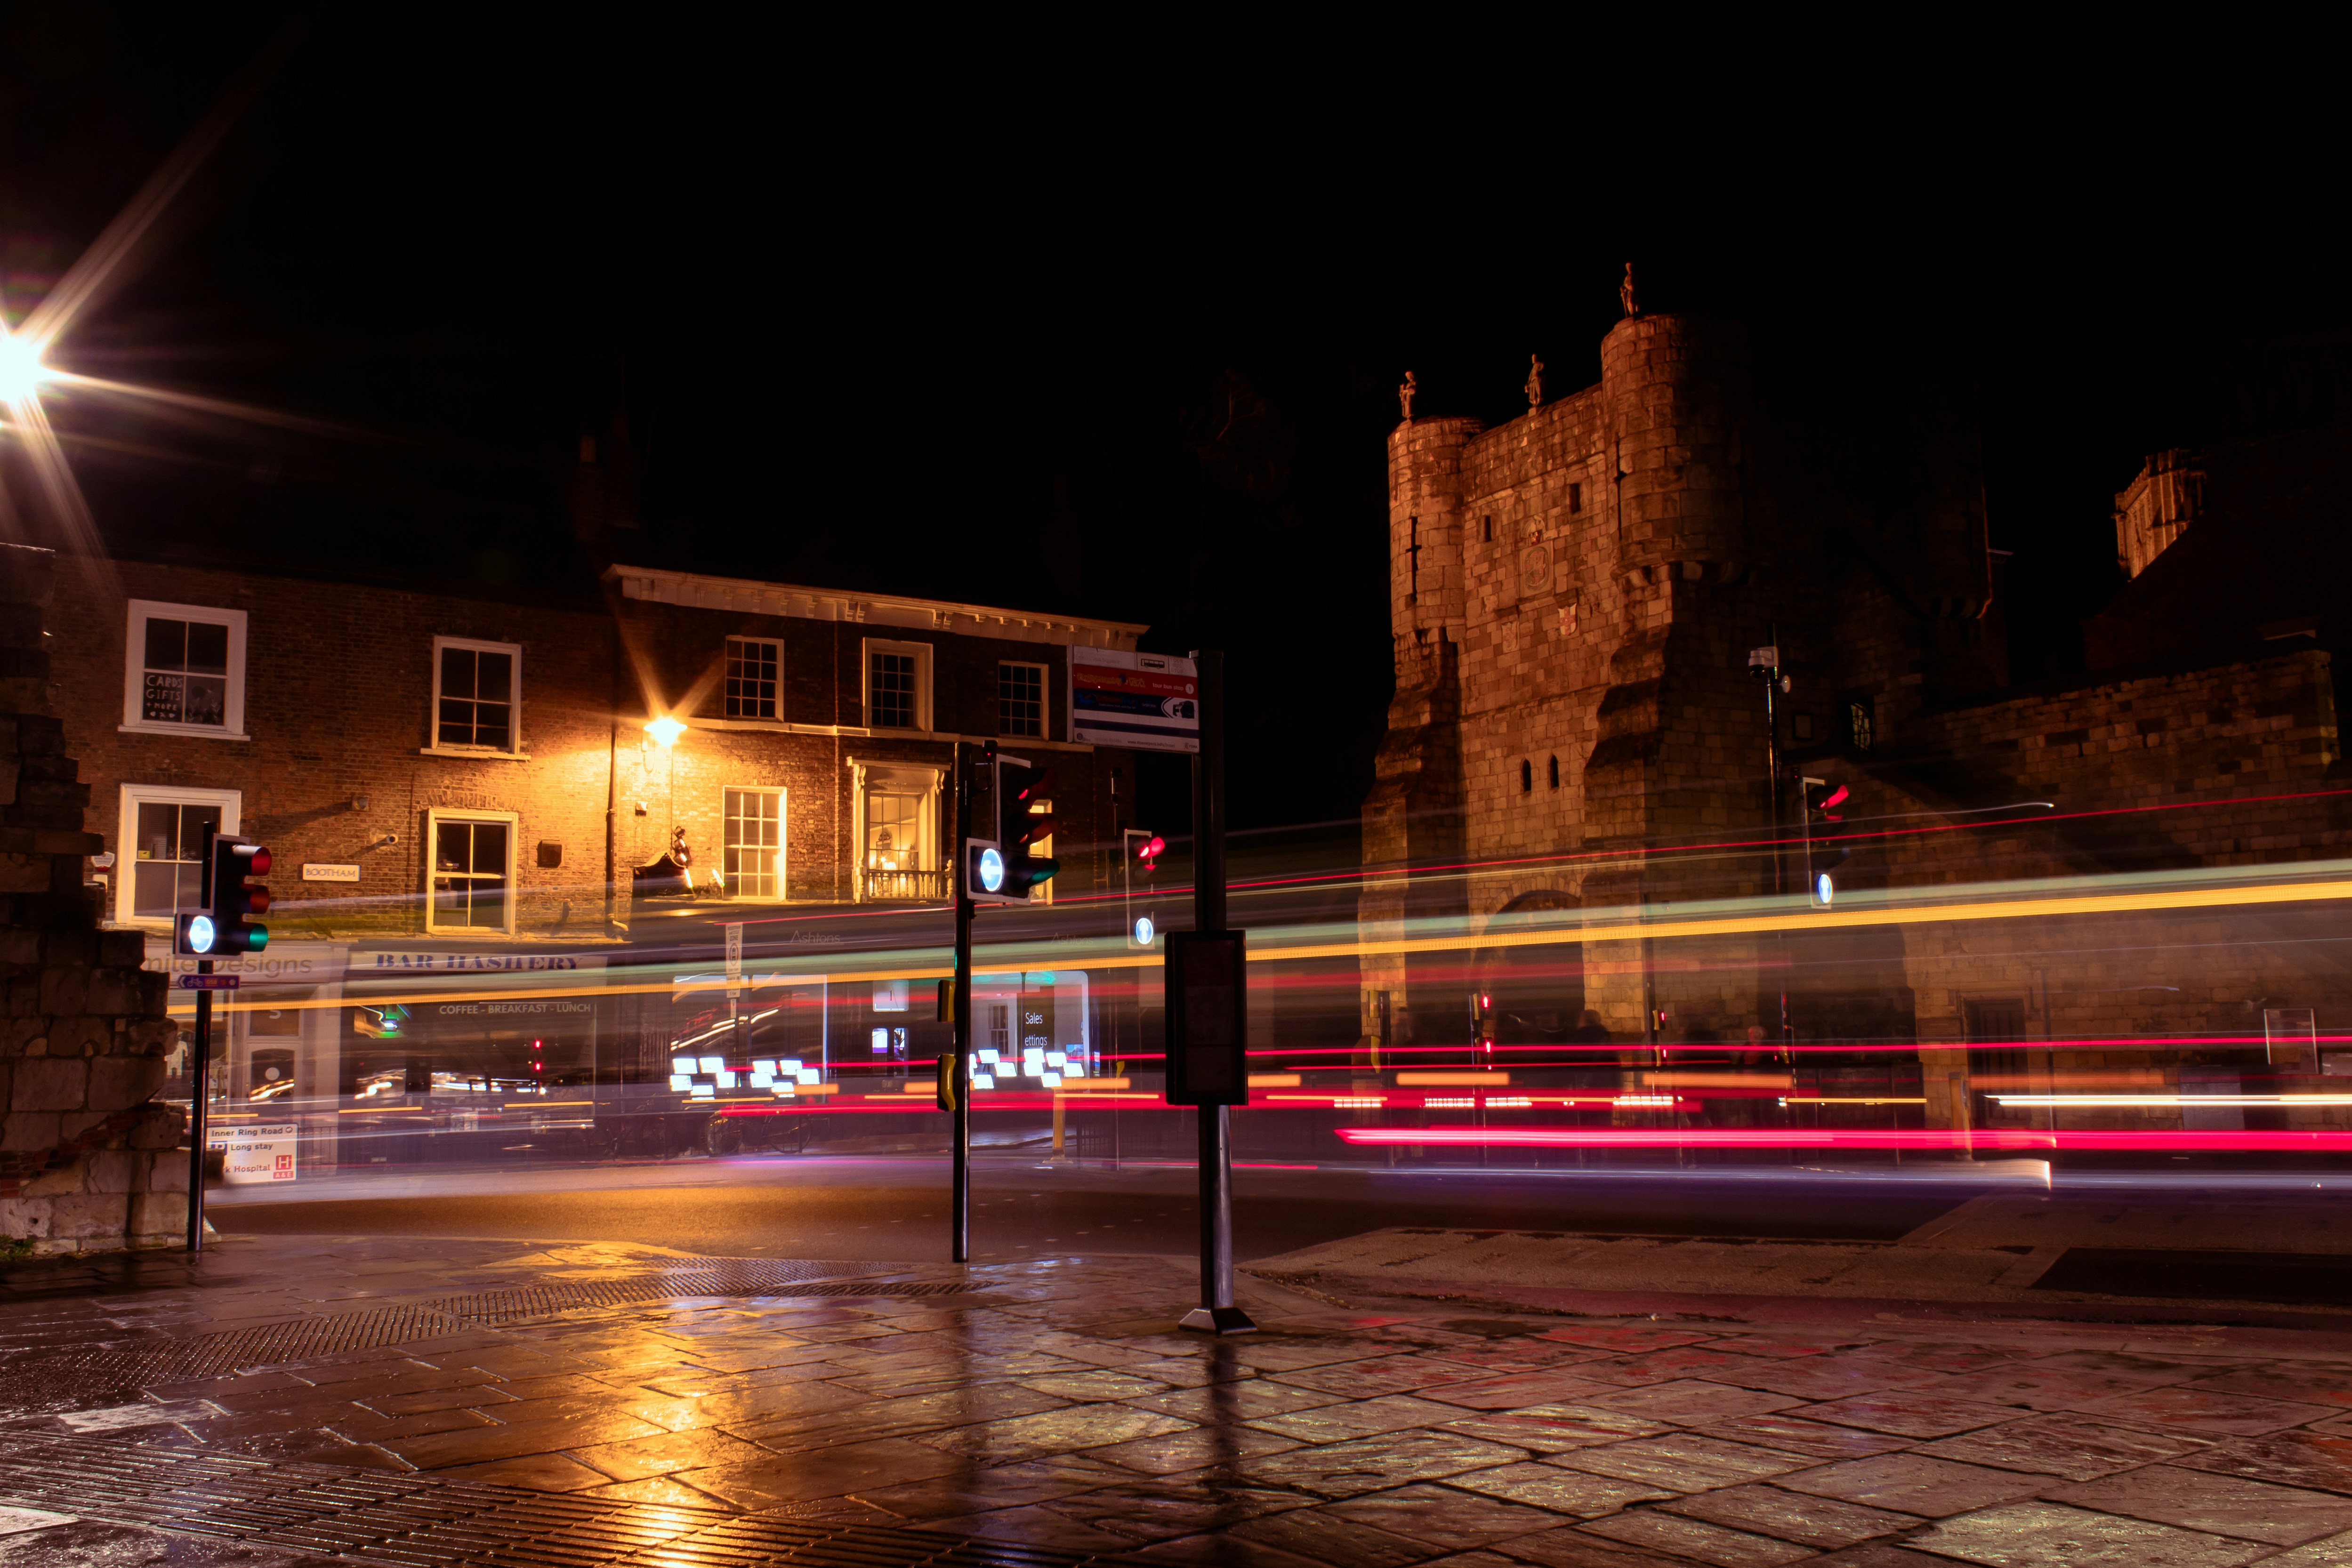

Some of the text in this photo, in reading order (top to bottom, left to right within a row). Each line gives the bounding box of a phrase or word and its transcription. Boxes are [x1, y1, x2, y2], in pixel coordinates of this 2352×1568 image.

[147, 675, 183, 688] CARDS
[146, 689, 181, 701] GIFTS
[154, 702, 177, 711] MORE
[306, 868, 356, 877] BOOTHAM
[790, 930, 840, 943] Ashtons
[145, 952, 197, 973] mile
[376, 954, 583, 970] BAR HASHERY
[439, 1005, 479, 1014] COFFEE
[488, 1004, 547, 1013] BREAKFAST
[557, 1003, 591, 1013] LUNCH
[1025, 1012, 1043, 1024] Sales
[1024, 1034, 1047, 1048] ettings
[238, 1128, 258, 1136] Ring
[261, 1126, 283, 1134] Road
[231, 1143, 252, 1151] Long
[255, 1142, 274, 1150] stay
[234, 1164, 271, 1173] Hospital
[278, 1156, 289, 1169] H
